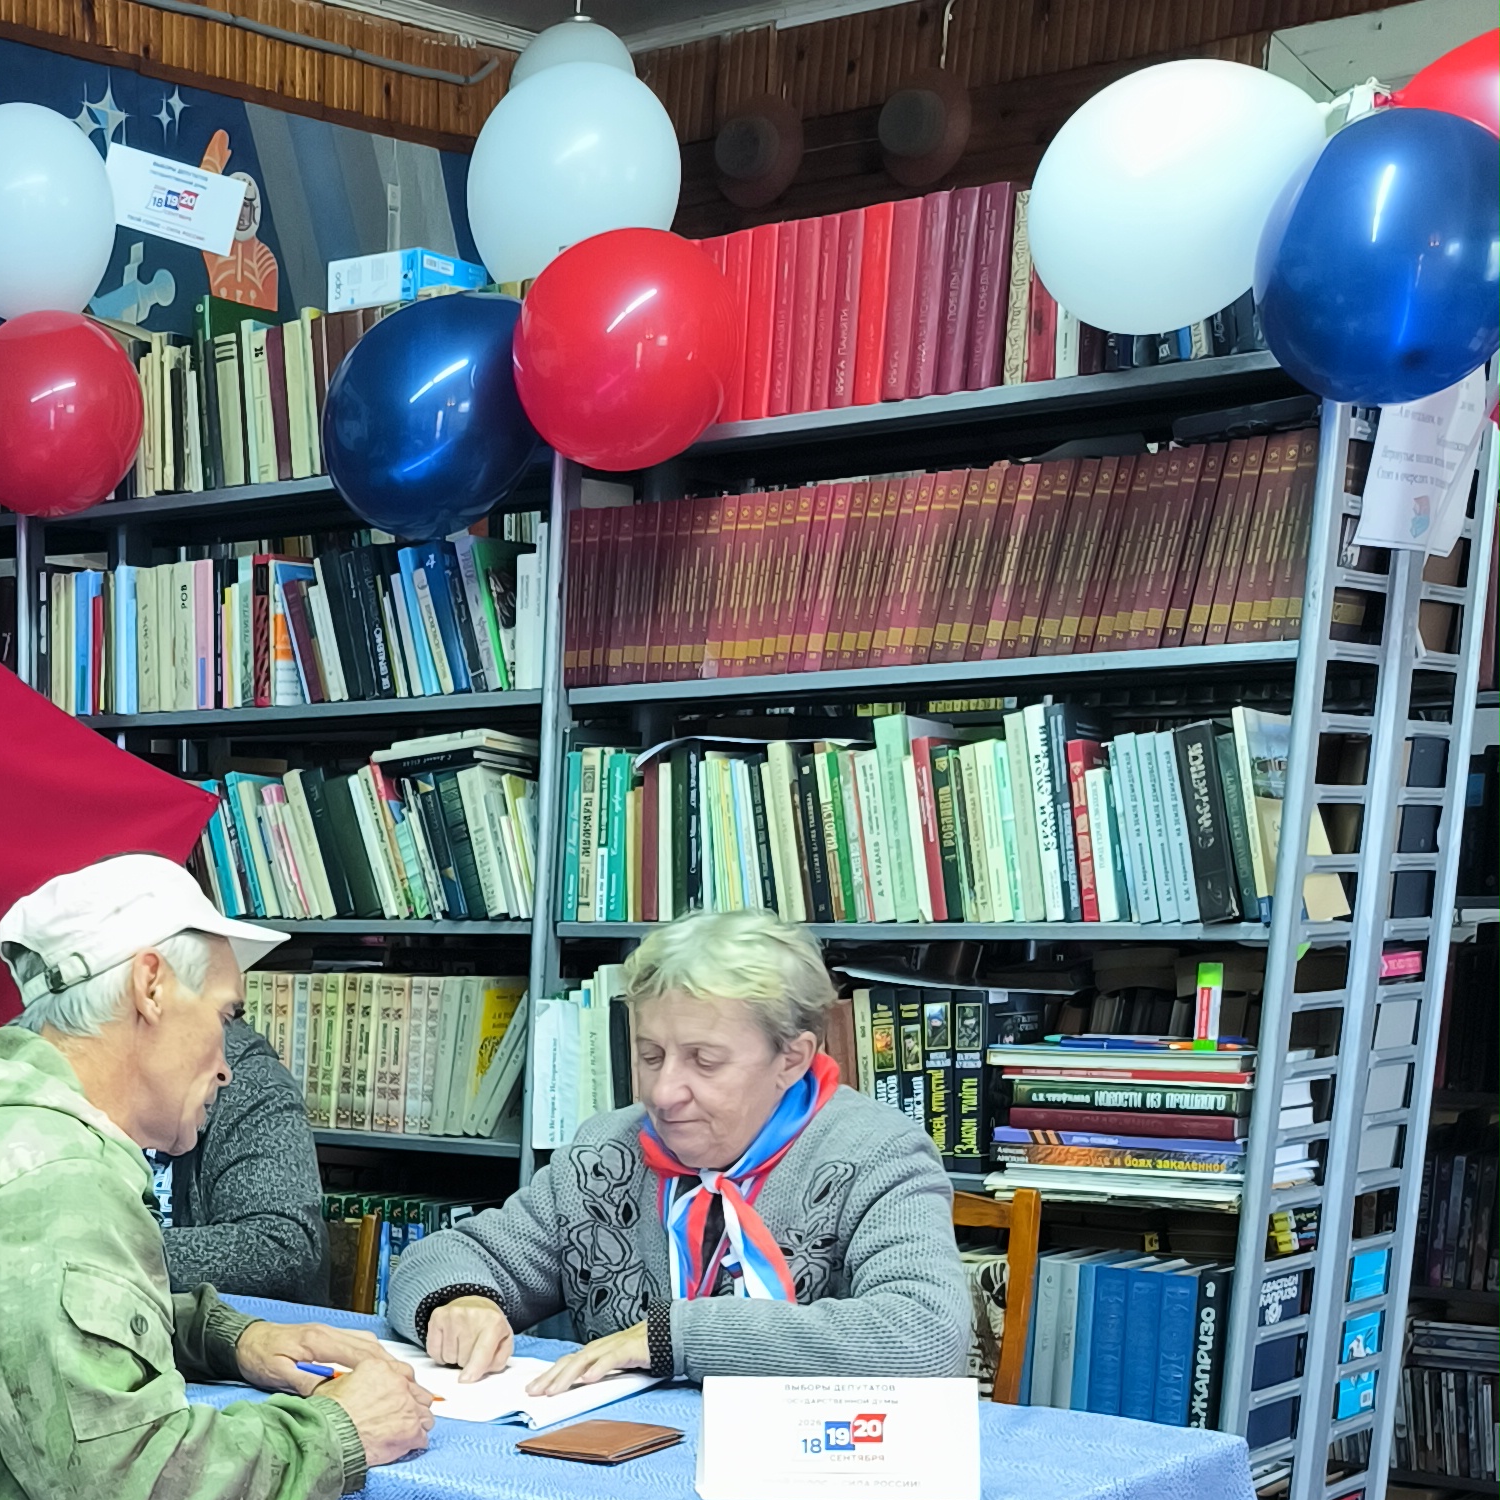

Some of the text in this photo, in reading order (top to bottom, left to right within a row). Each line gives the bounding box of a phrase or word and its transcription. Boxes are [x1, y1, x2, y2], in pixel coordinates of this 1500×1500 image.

[152, 192, 195, 208] 18 19 20
[1123, 752, 1138, 802] ДЕМИДОВСКОЙ
[1145, 752, 1160, 802] ДЕМИДОВСКОЙ
[1163, 750, 1178, 801] ДЕМИДОВСКОЙ
[1033, 754, 1051, 852] КРАЙ МОЙ
[1171, 803, 1180, 826] ЗЕМЛЕ
[822, 803, 838, 850] ИСТОРИЯ
[1131, 804, 1140, 827] ЗЕМЛЕ
[1153, 804, 1162, 827] ЗЕМЛЕ
[1135, 828, 1142, 837] НА
[1157, 828, 1163, 837] НА
[1175, 827, 1182, 837] НА
[873, 841, 882, 875] БУДАЕВ
[1095, 1091, 1226, 1110] НОВОСТИ ИЗ ПРОШЛОГО
[1124, 1155, 1152, 1168] боях
[1156, 1160, 1226, 1172] закаленное
[784, 1384, 896, 1392] ВЫБОРЫ ДЕПУТАТОВ
[801, 1419, 882, 1454] 18 19 20
[830, 1454, 885, 1462] СЕНТЯБРЯ
